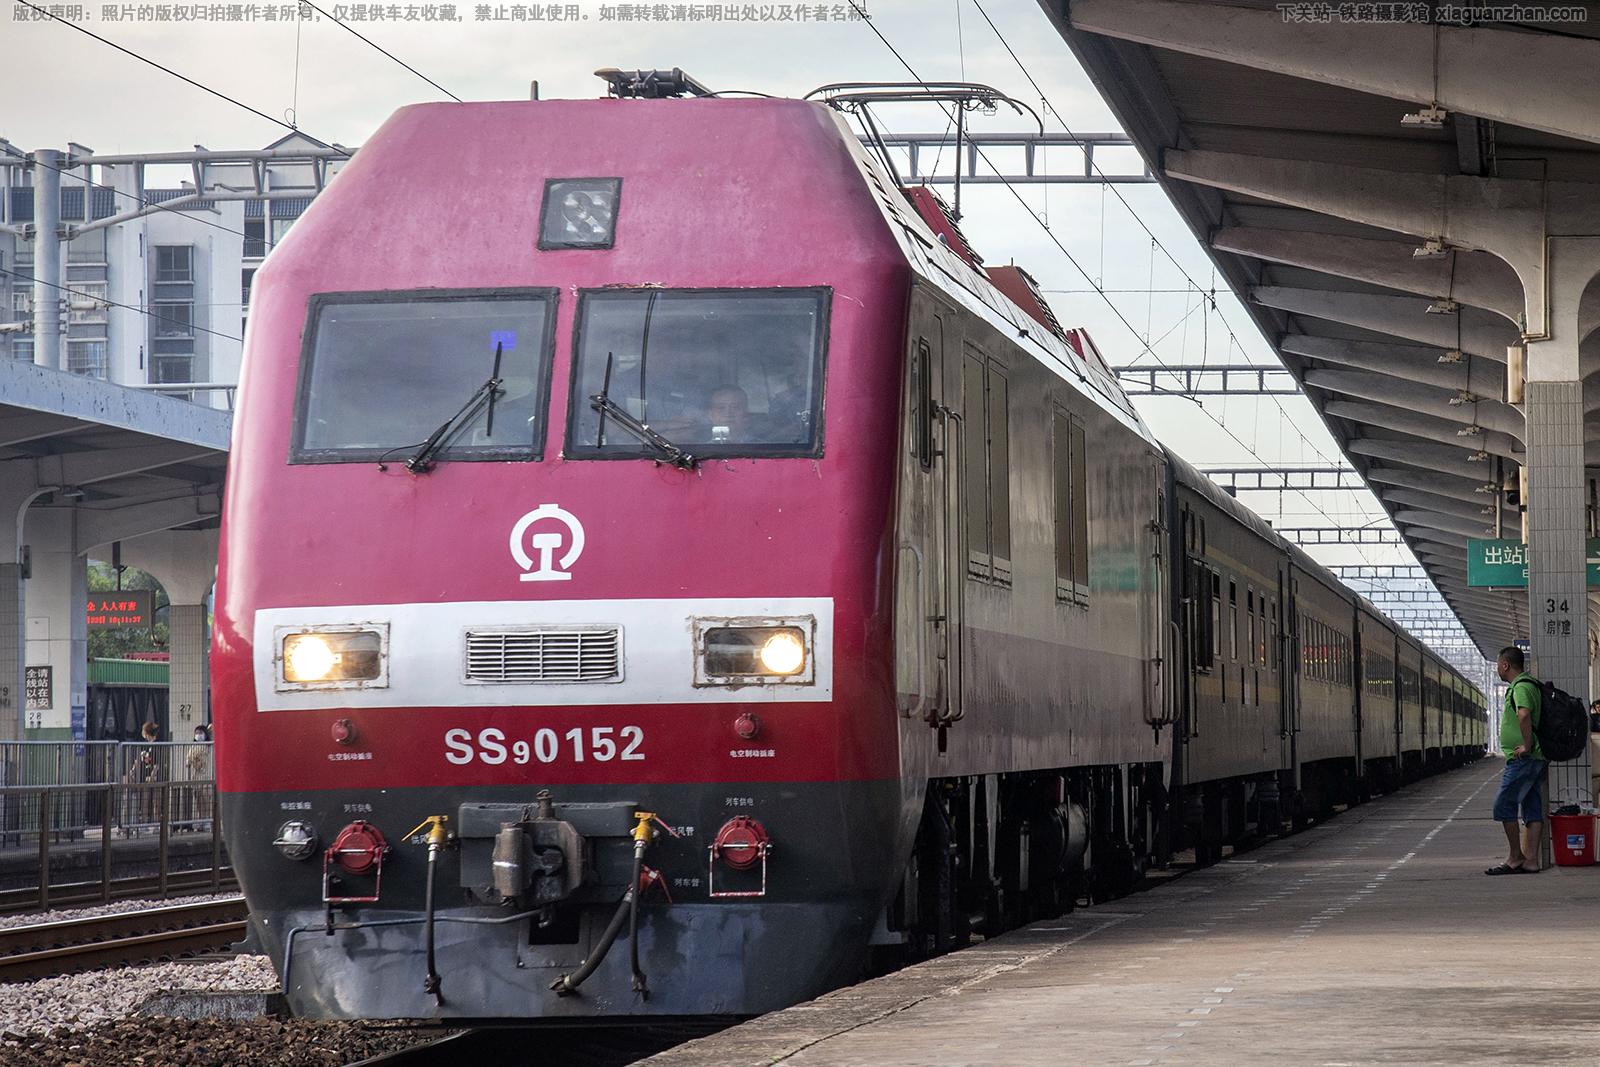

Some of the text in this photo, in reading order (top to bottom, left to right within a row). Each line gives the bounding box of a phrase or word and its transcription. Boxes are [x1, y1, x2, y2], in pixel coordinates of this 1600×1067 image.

[1484, 545, 1529, 565] 出站
[1546, 598, 1569, 613] 34
[1546, 620, 1571, 635] 房建
[29, 711, 42, 721] 28
